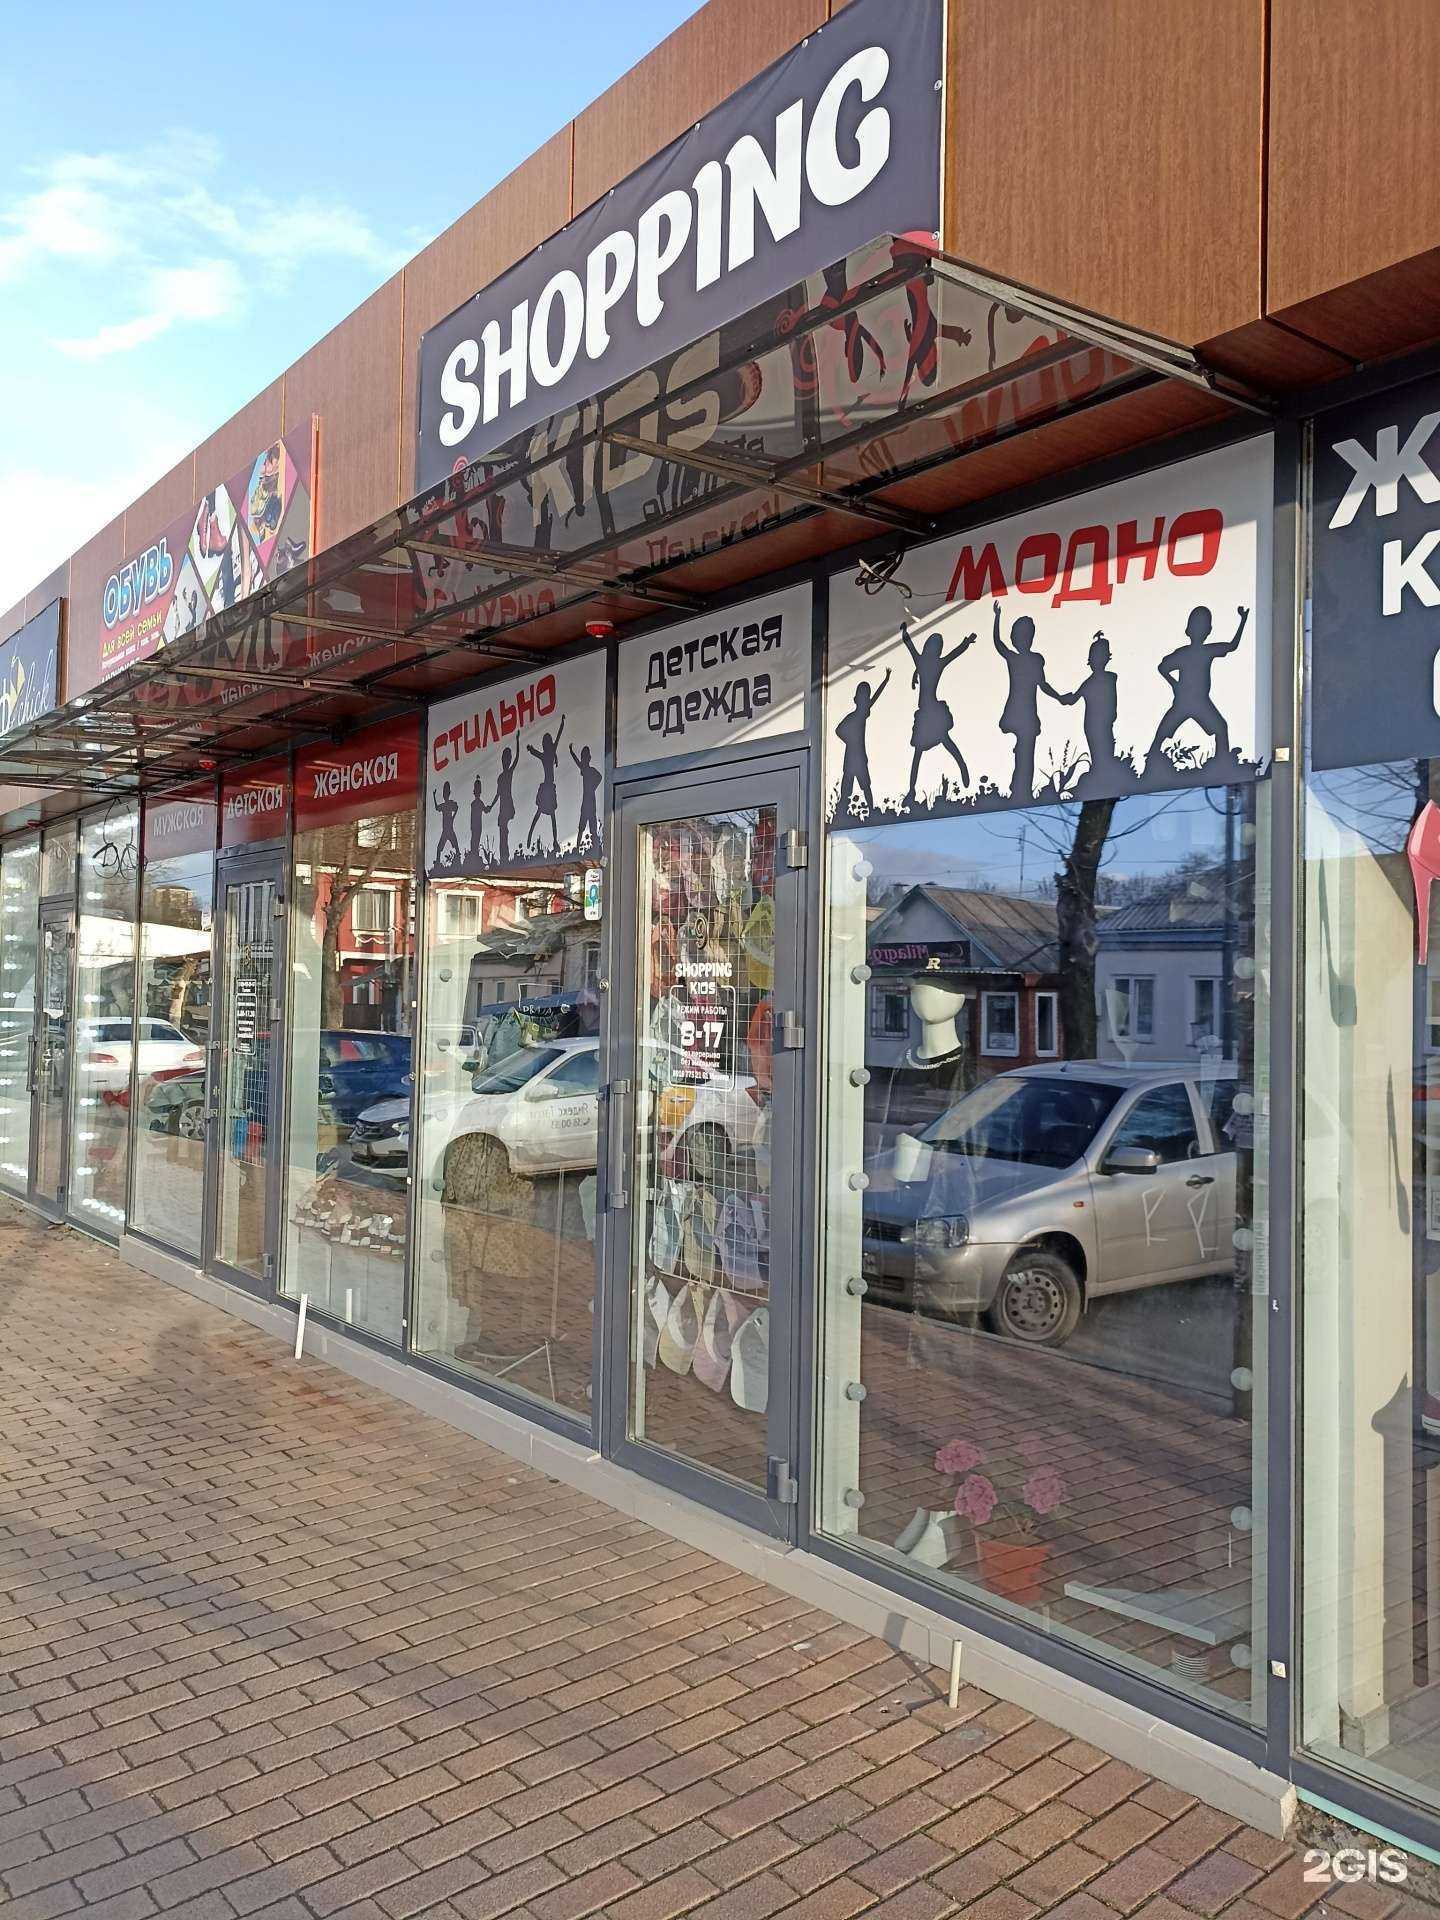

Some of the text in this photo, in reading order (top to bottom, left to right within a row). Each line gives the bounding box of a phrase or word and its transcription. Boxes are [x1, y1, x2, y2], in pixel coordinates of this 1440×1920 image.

[439, 46, 891, 447] SHOPPING
[103, 537, 174, 629] ОБУВЬ
[946, 508, 1224, 609] МОДНО
[433, 674, 557, 772] СТИЛЬНО
[313, 751, 399, 800] женская
[153, 805, 205, 837] мужская
[225, 785, 284, 820] детская
[675, 963, 733, 978] SHOPPING
[690, 981, 716, 995] KIDS
